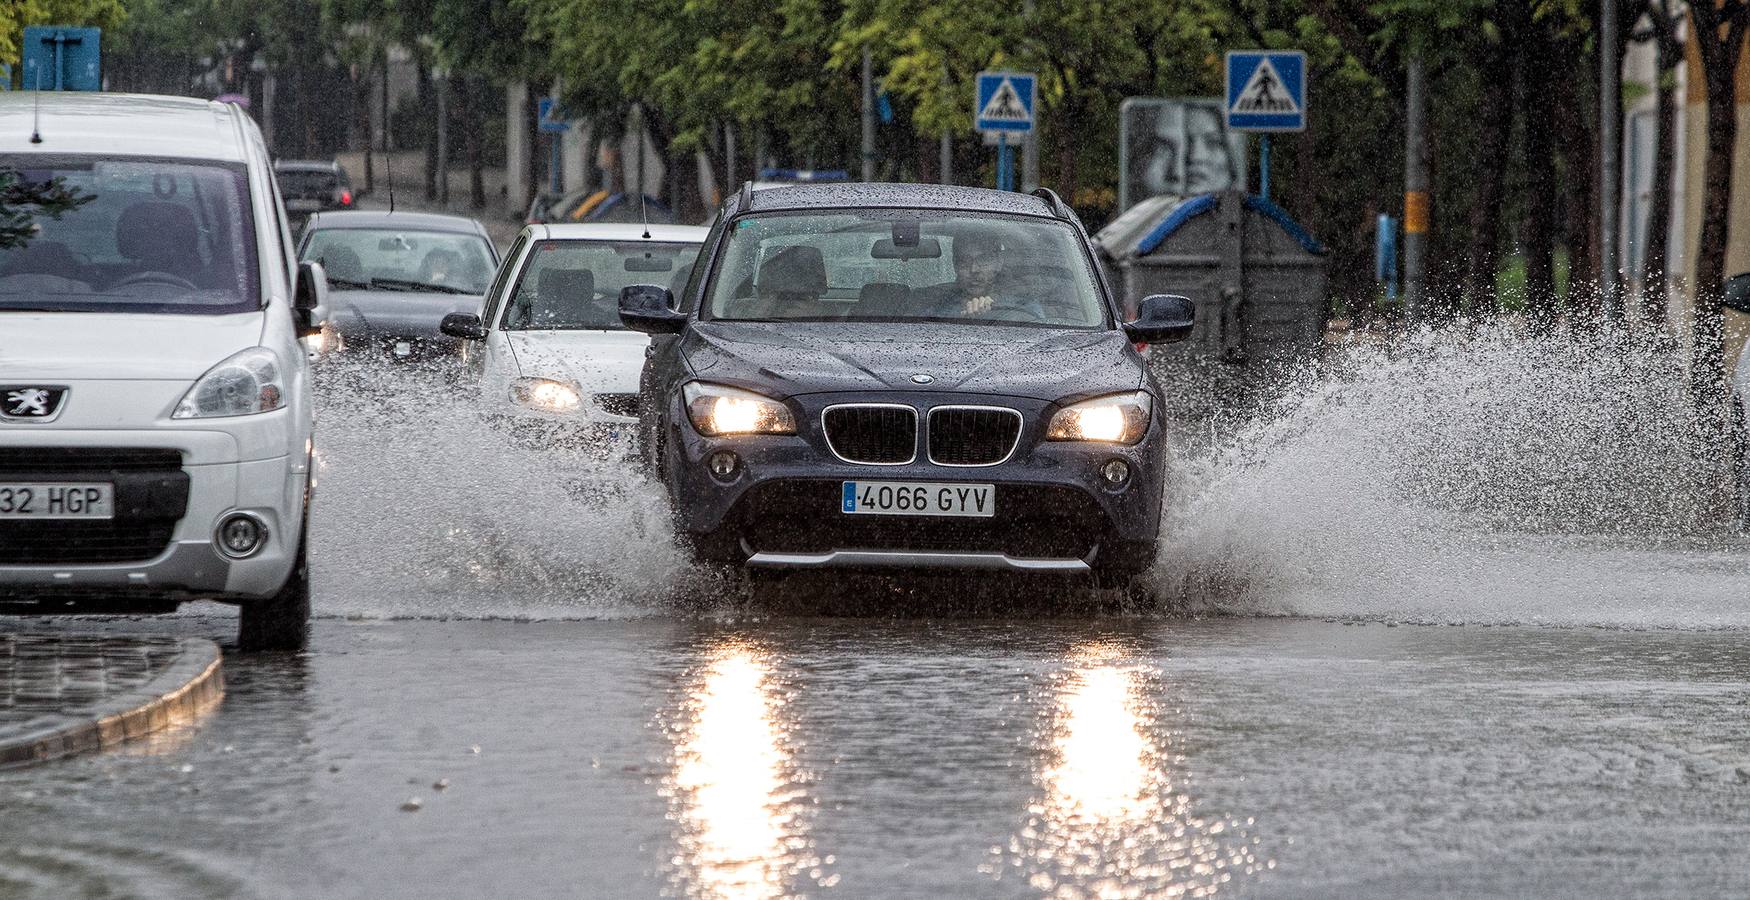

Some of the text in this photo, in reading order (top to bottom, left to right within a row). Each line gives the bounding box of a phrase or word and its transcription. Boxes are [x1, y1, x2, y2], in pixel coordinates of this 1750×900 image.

[48, 488, 101, 514] HGP
[861, 486, 988, 513] 4066 GYV
